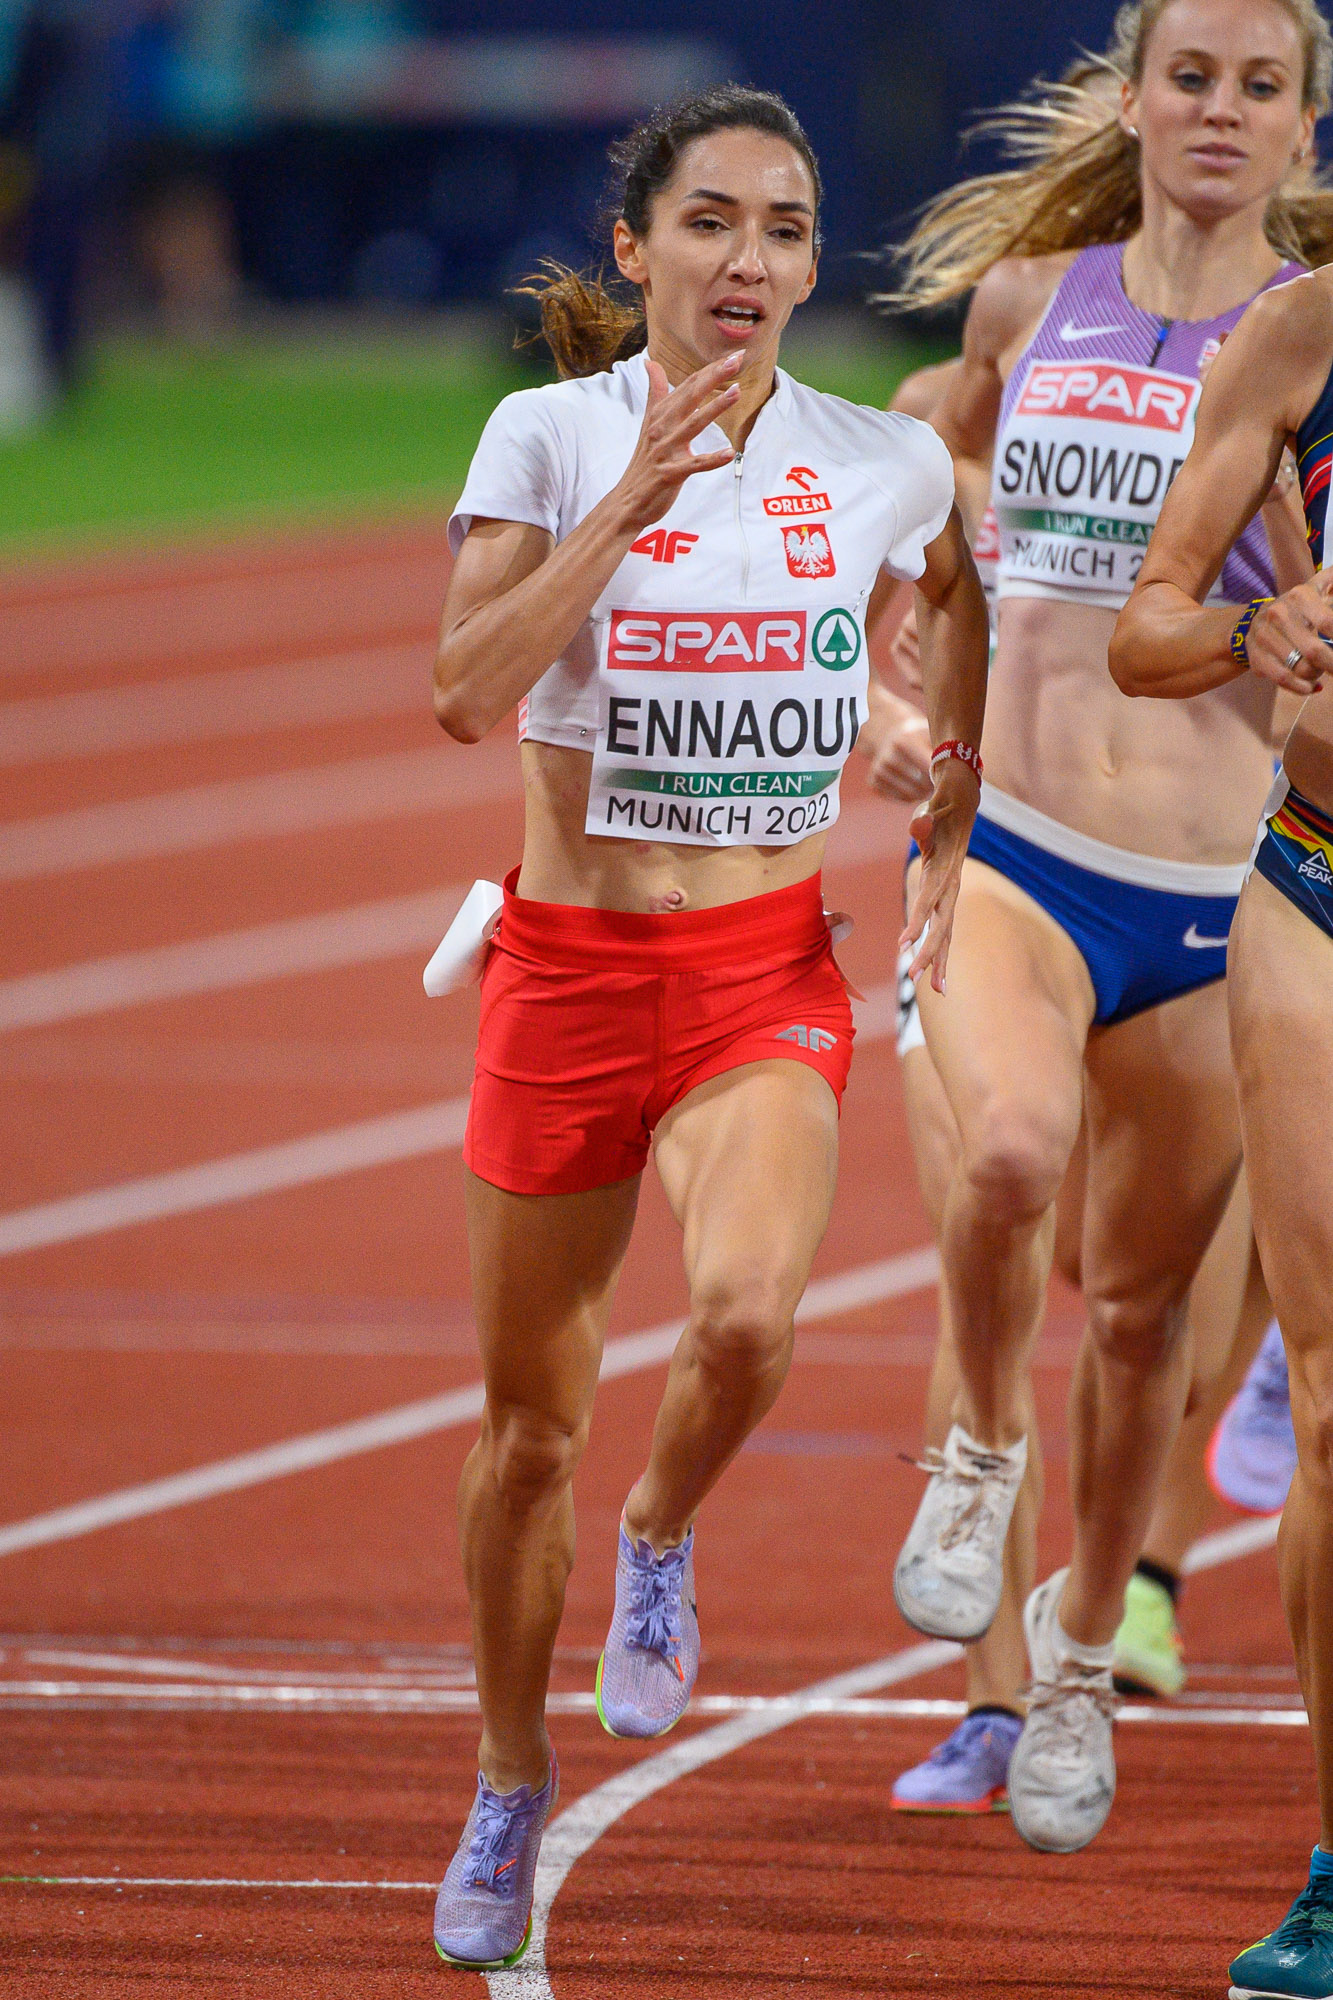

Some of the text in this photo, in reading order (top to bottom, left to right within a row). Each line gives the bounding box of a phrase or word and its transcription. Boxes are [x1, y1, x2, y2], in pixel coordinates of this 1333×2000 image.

[1023, 371, 1187, 425] SPAR
[767, 495, 827, 514] ORLEN
[1054, 513, 1087, 534] RUN
[1092, 518, 1155, 543] CLEA
[629, 529, 699, 564] 4F
[1012, 538, 1115, 579] MUNICH
[614, 619, 801, 663] SPAR
[606, 696, 859, 758] ENNAOUI
[659, 774, 665, 790] I
[673, 775, 722, 795] RUN
[606, 793, 830, 835] MUNICH 2022
[1297, 863, 1333, 886] PEAK
[775, 1024, 838, 1053] 4F
